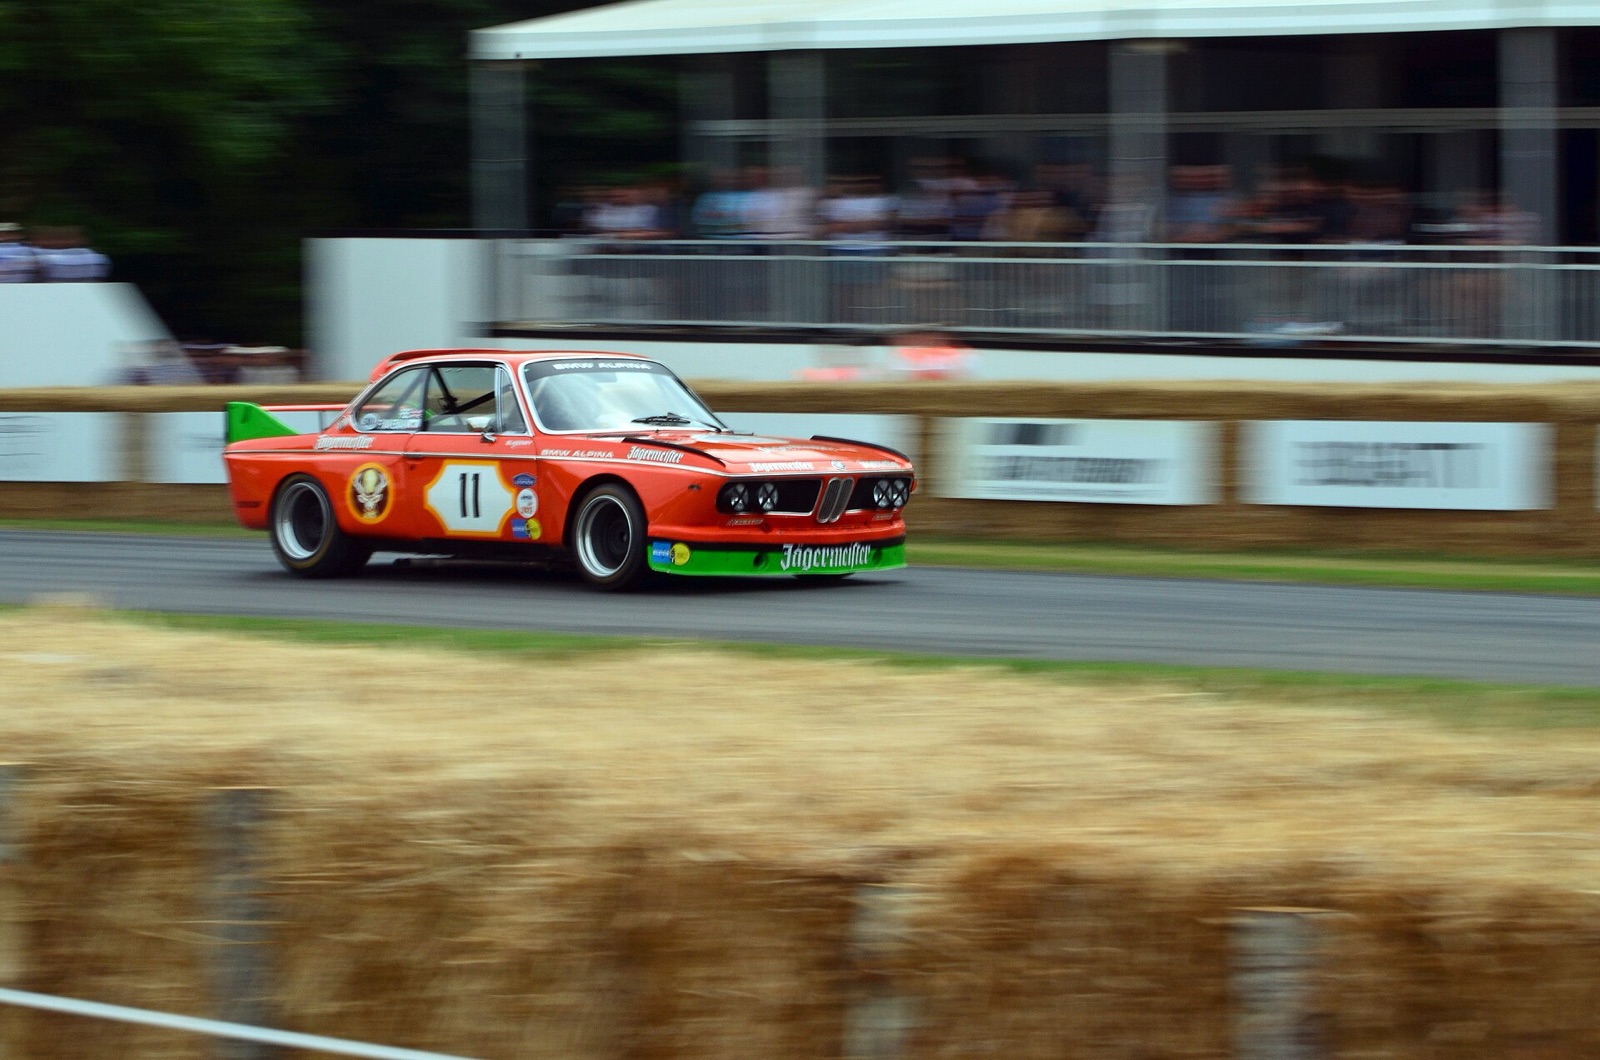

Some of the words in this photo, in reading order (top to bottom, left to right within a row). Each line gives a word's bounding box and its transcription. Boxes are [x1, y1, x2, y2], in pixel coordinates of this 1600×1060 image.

[540, 448, 570, 457] BMW
[572, 449, 614, 459] ALPINA
[459, 472, 480, 519] 11
[780, 541, 871, 572] Jägermeister
